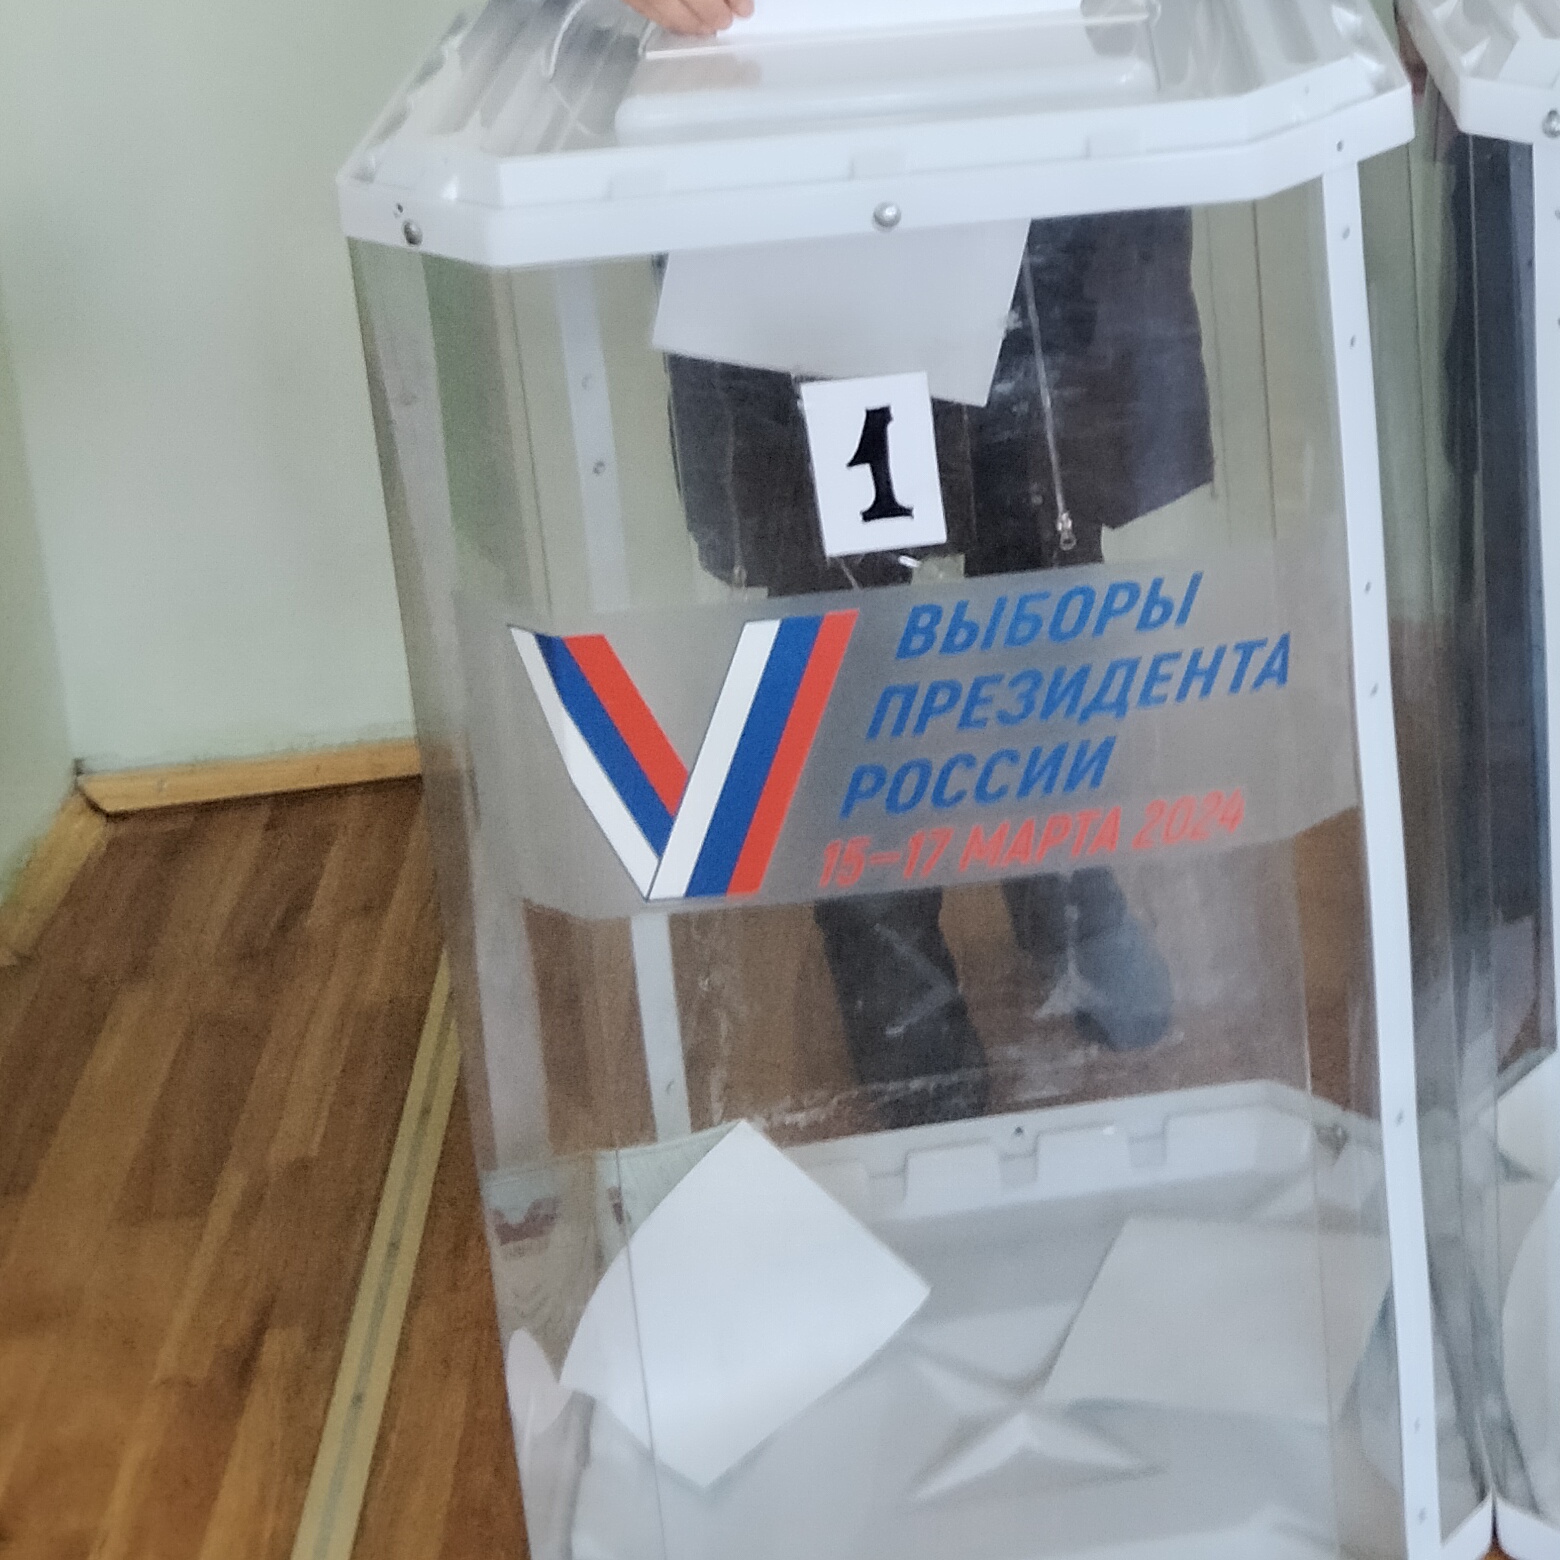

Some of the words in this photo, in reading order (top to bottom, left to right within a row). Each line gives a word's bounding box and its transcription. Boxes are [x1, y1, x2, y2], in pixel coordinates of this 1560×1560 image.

[845, 404, 915, 522] 1
[895, 571, 1203, 661] ВЫБОРЫ
[865, 632, 1292, 742] ПРЕЗИДЕНТА
[840, 736, 1117, 821] РОССИИ
[958, 805, 1122, 873] МАРТА
[1132, 786, 1246, 851] 2024
